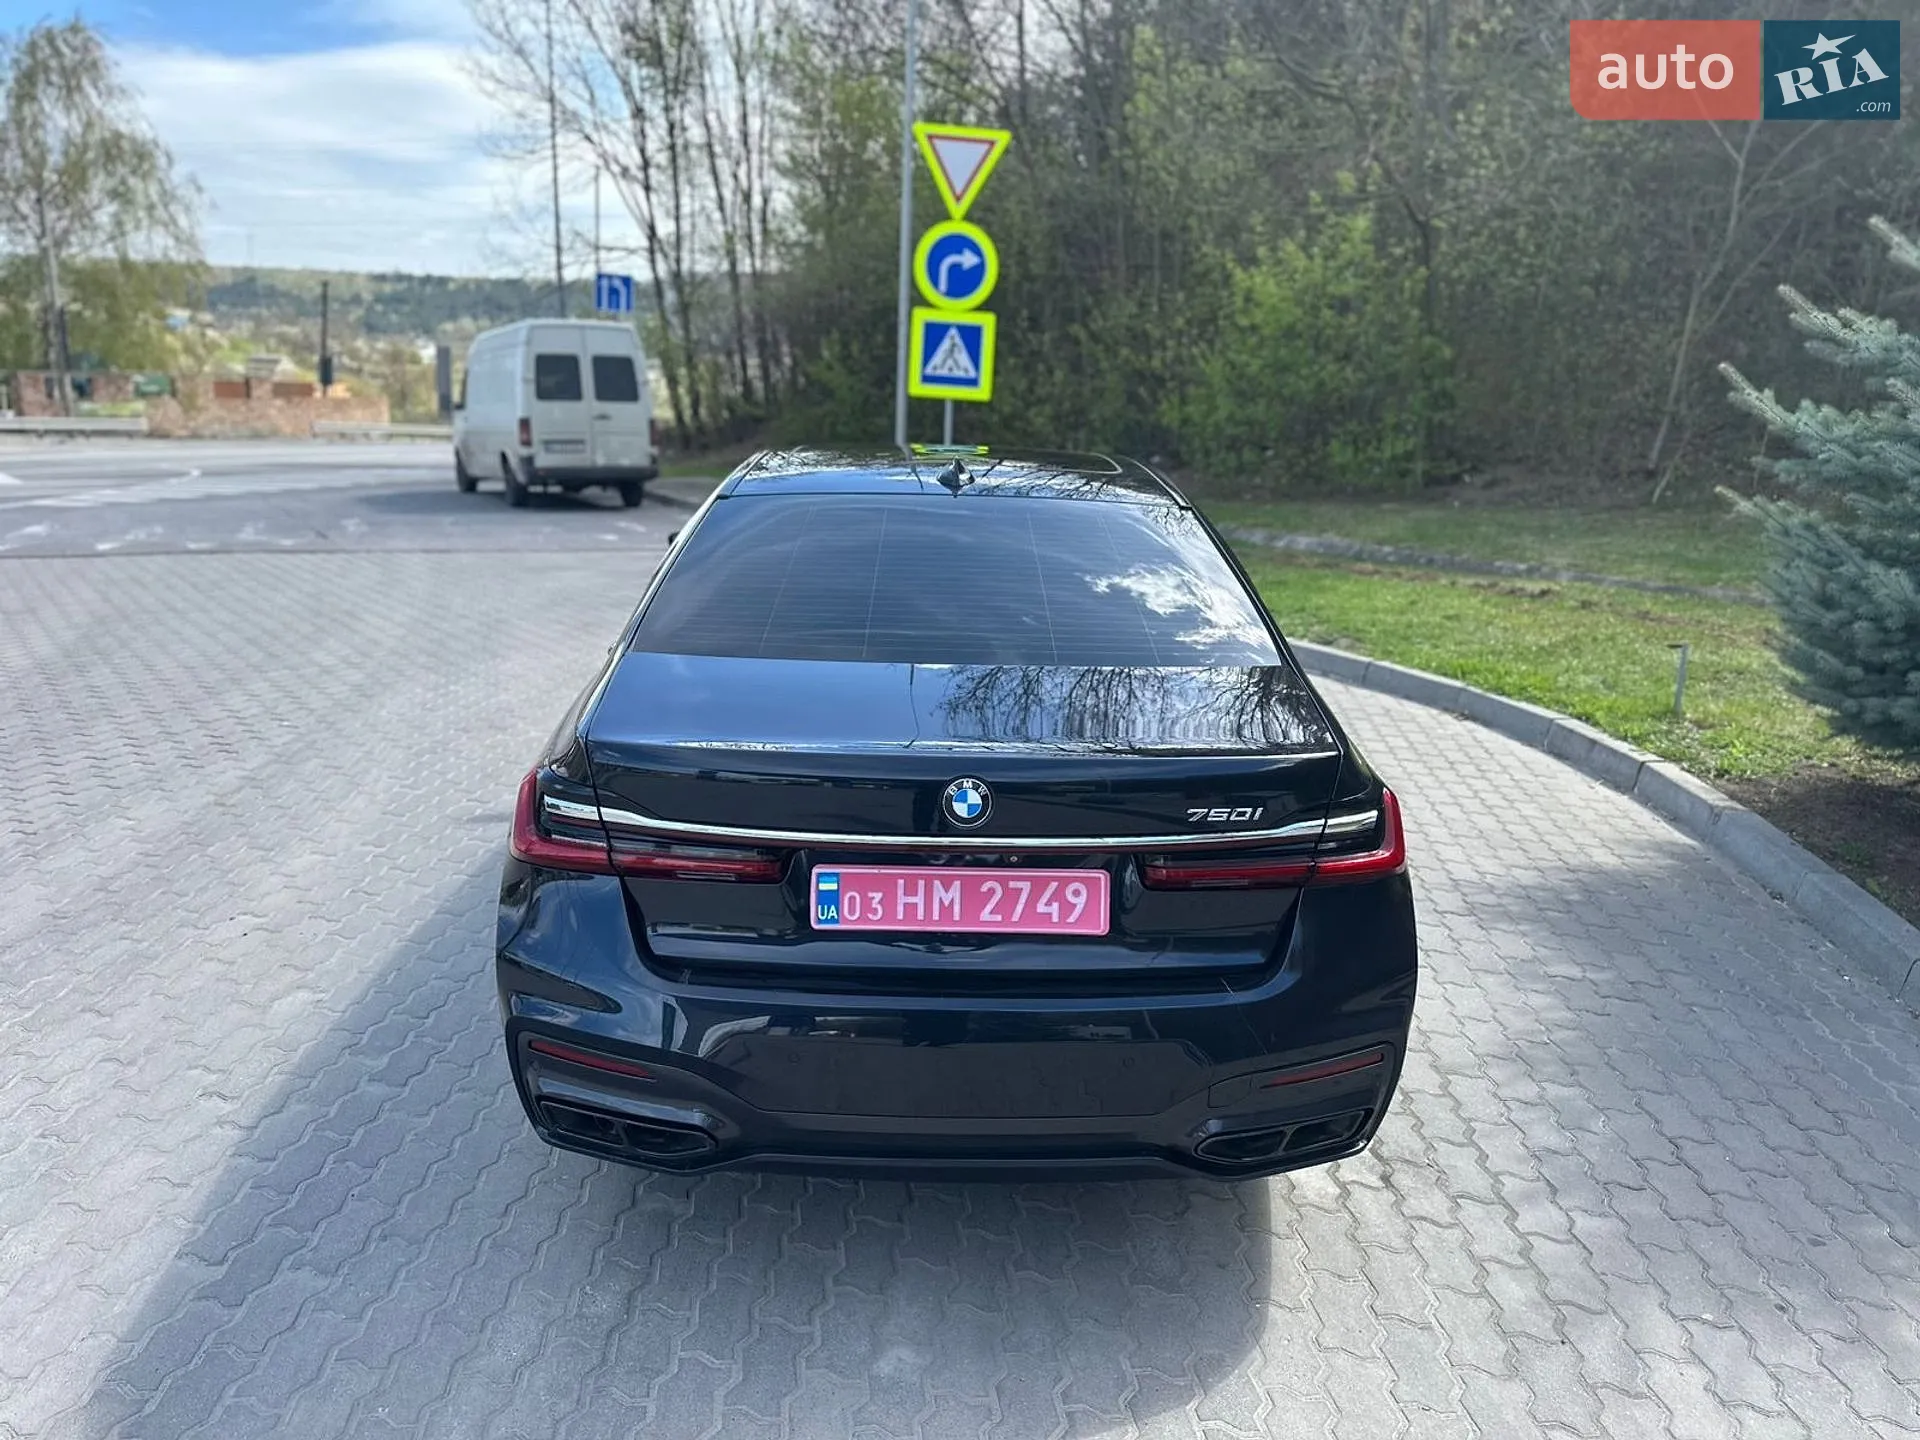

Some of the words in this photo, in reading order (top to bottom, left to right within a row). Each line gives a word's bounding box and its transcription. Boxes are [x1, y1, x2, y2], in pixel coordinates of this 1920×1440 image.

[818, 904, 839, 920] UA
[843, 891, 884, 922] 03
[896, 879, 961, 922] HM
[979, 880, 1088, 925] 2749
